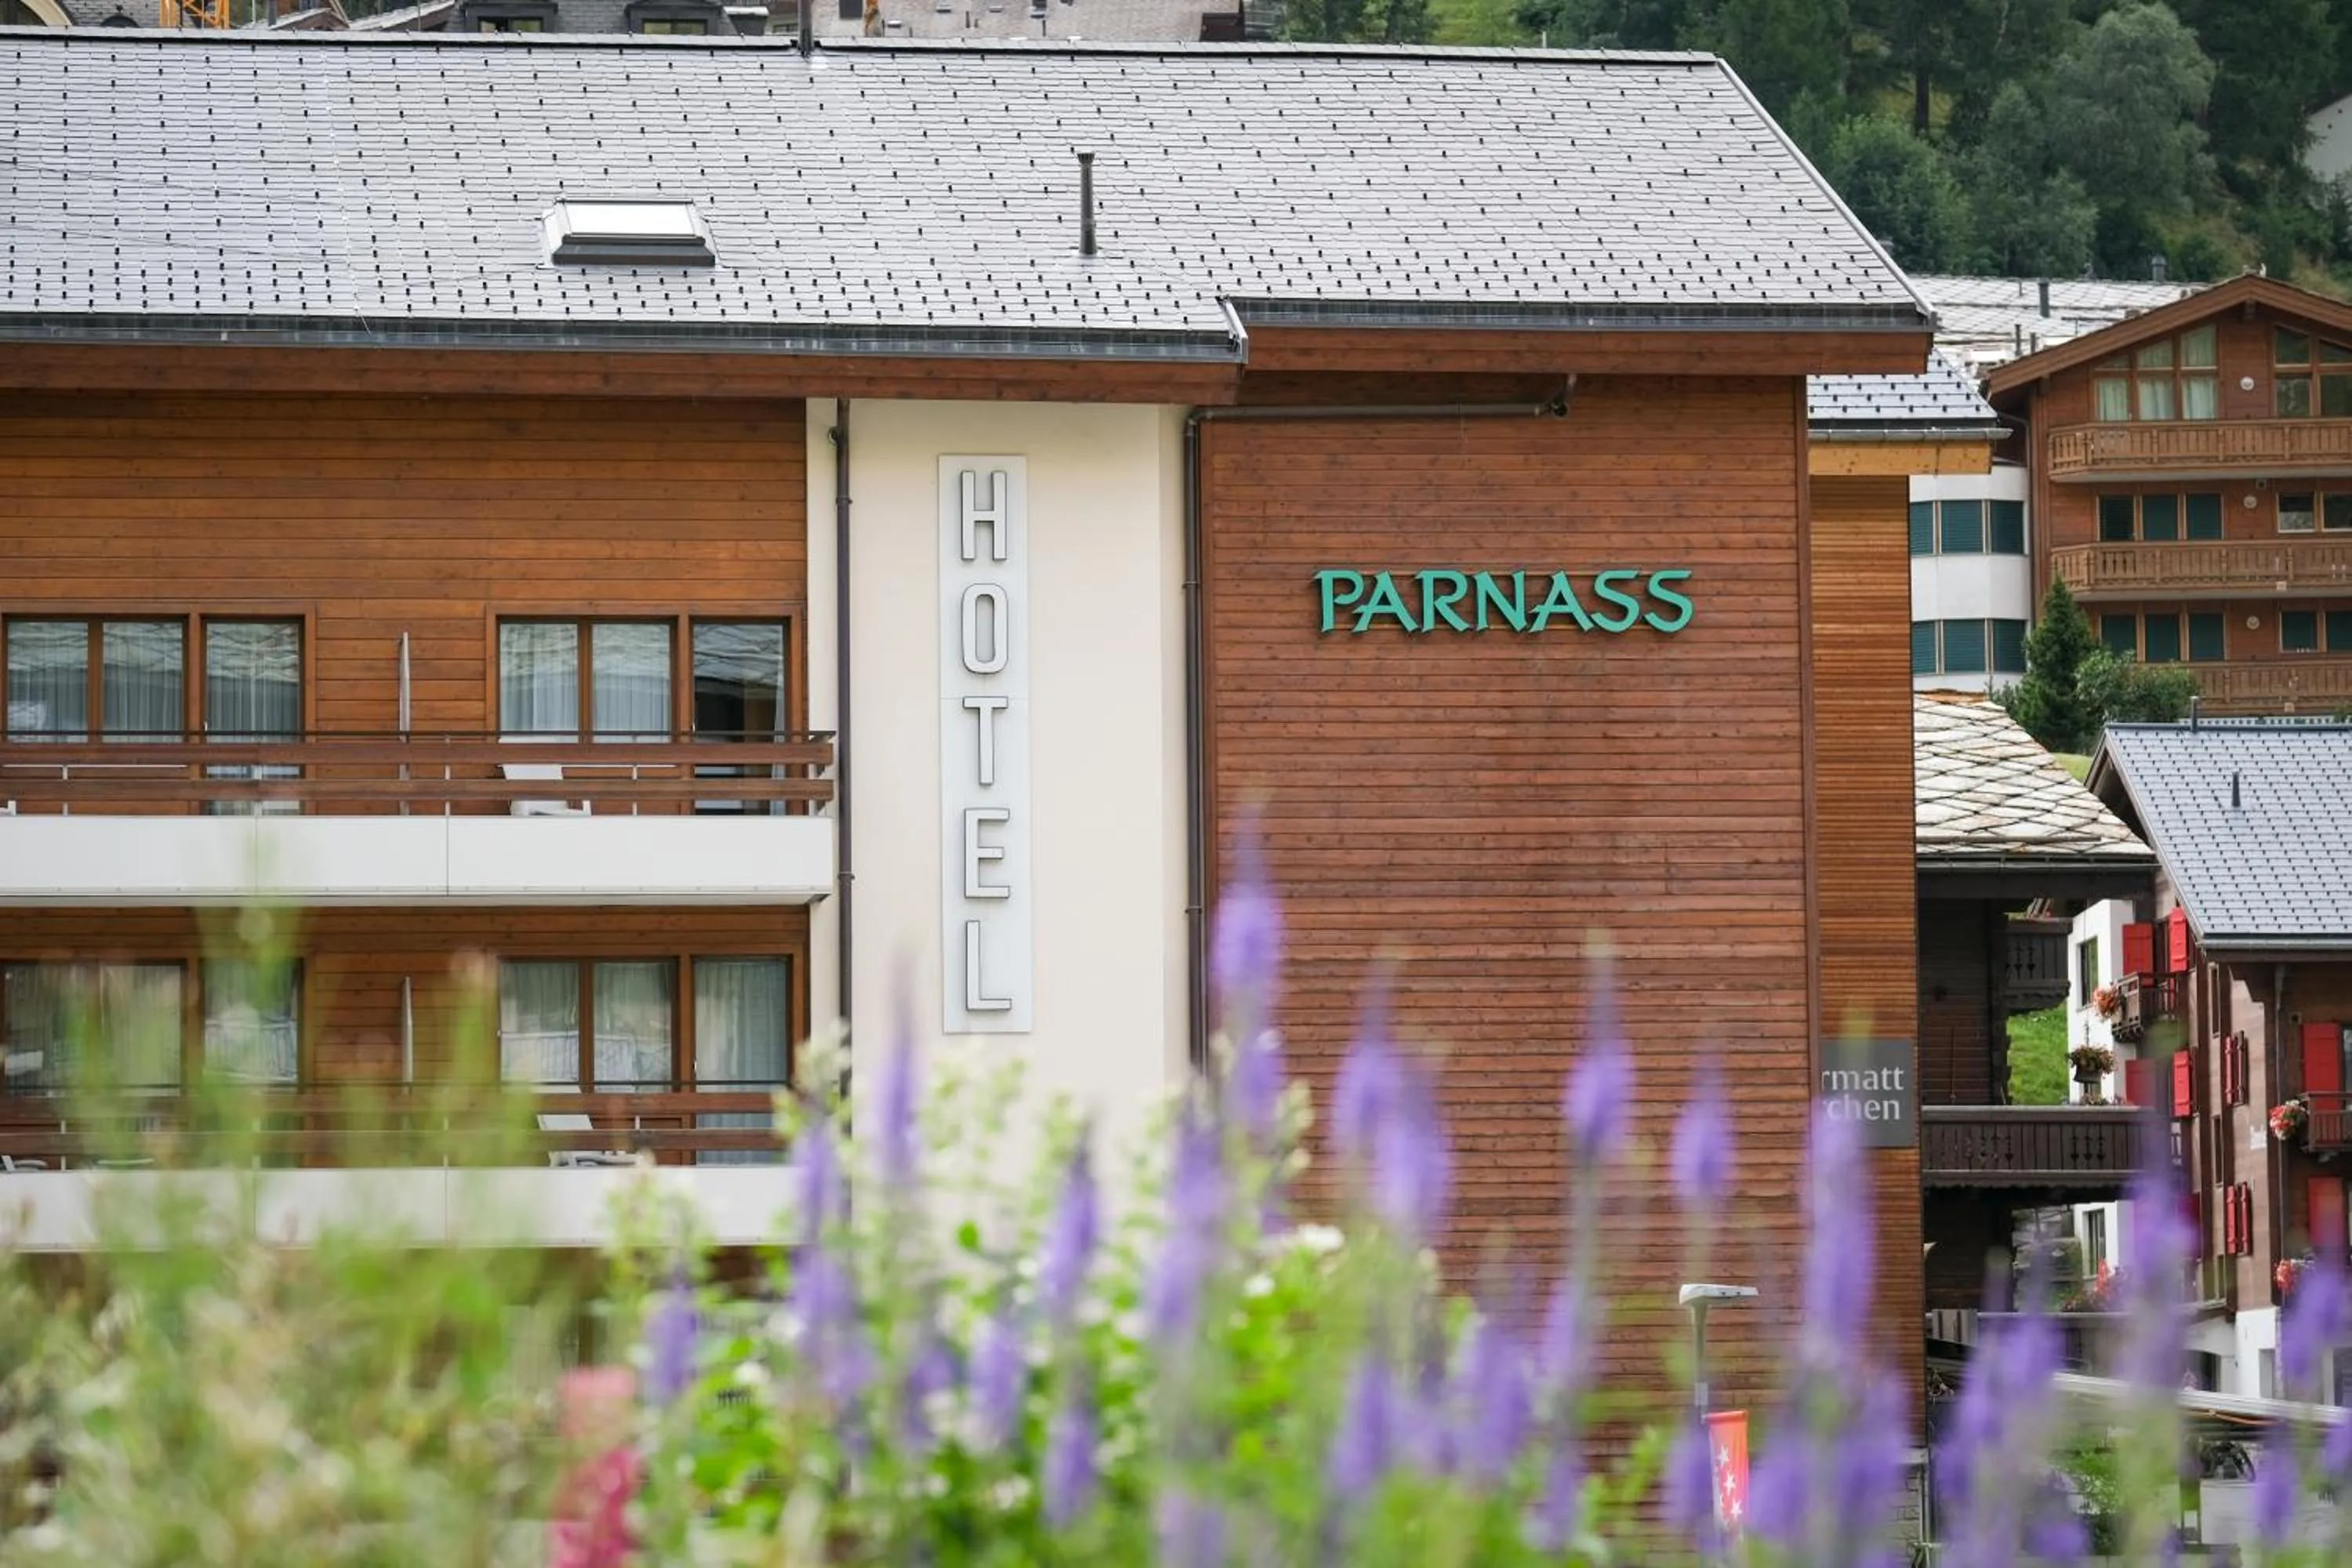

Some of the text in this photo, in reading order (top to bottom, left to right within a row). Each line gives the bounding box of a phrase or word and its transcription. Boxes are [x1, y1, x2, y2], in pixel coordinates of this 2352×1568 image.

[1313, 569, 1694, 633] PARNASS
[960, 470, 1012, 1012] HOTEL
[1823, 1094, 1900, 1120] chen
